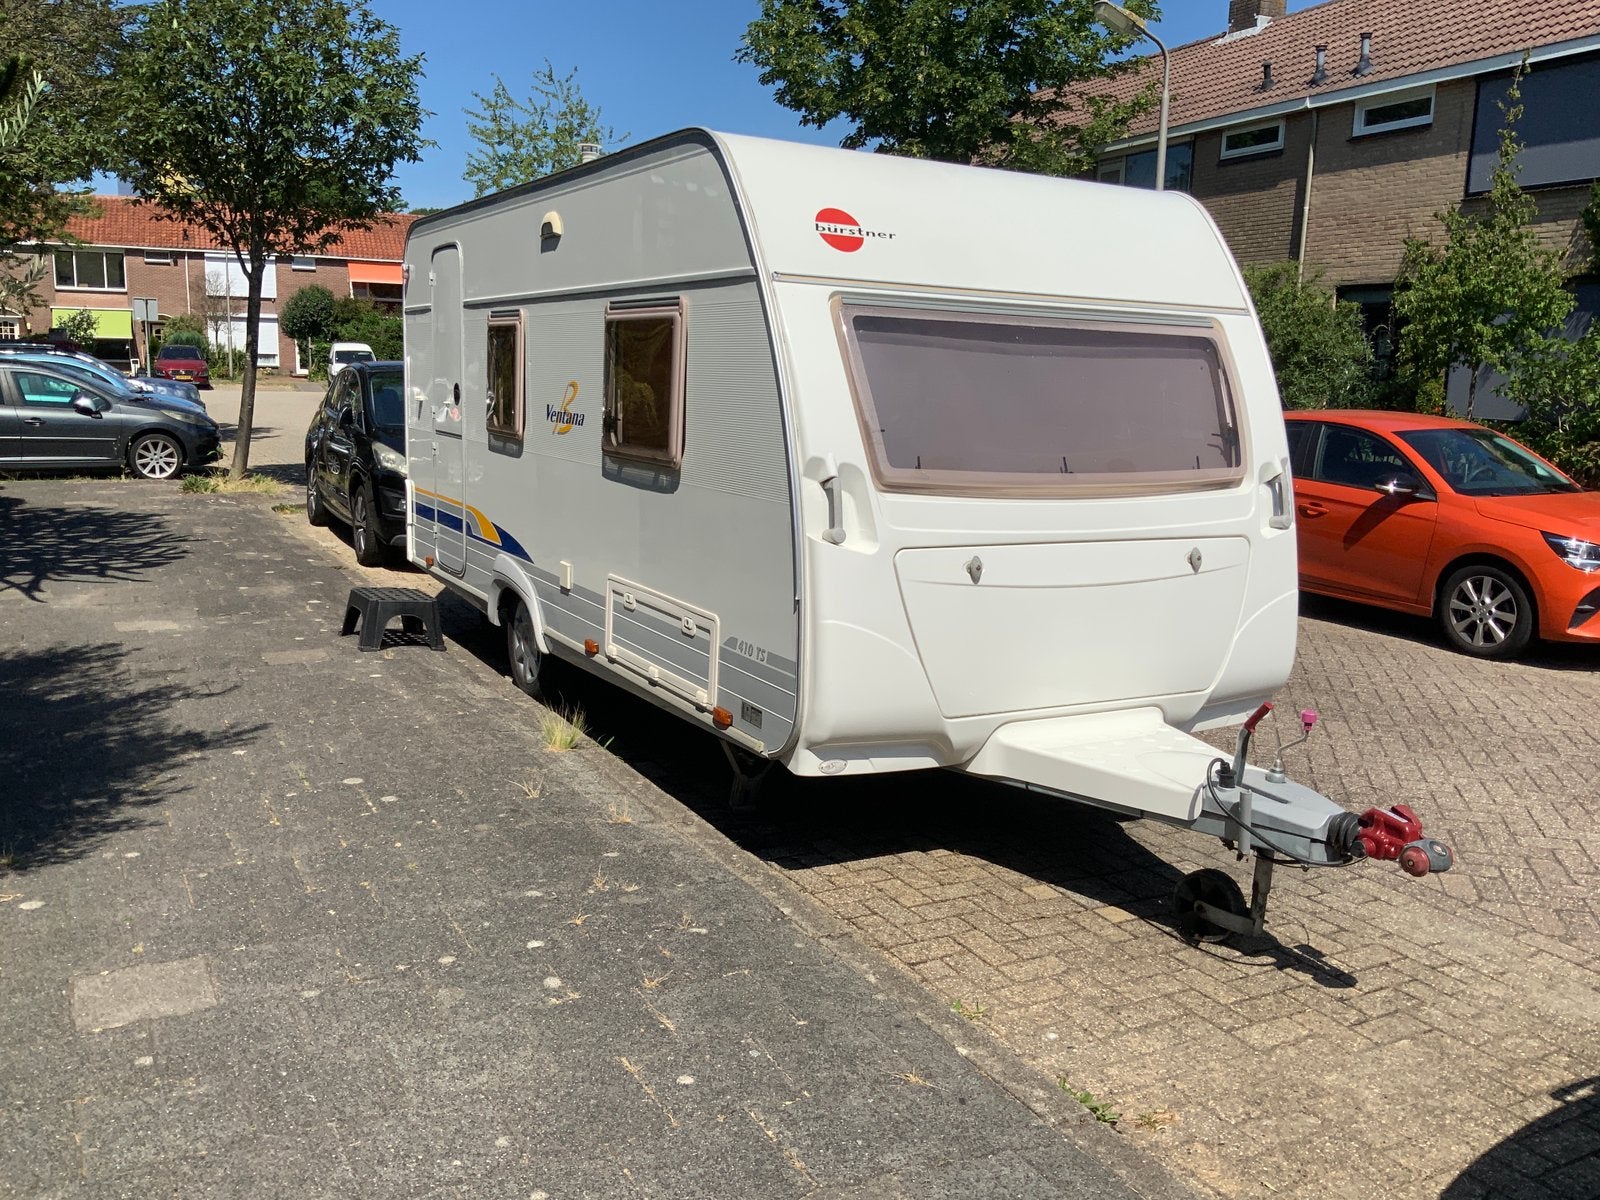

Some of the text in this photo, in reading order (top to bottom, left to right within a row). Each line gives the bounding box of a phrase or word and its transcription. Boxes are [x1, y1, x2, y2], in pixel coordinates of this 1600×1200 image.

[815, 223, 897, 239] bürstner
[546, 404, 585, 426] Ventana
[738, 640, 766, 662] 410 TS
